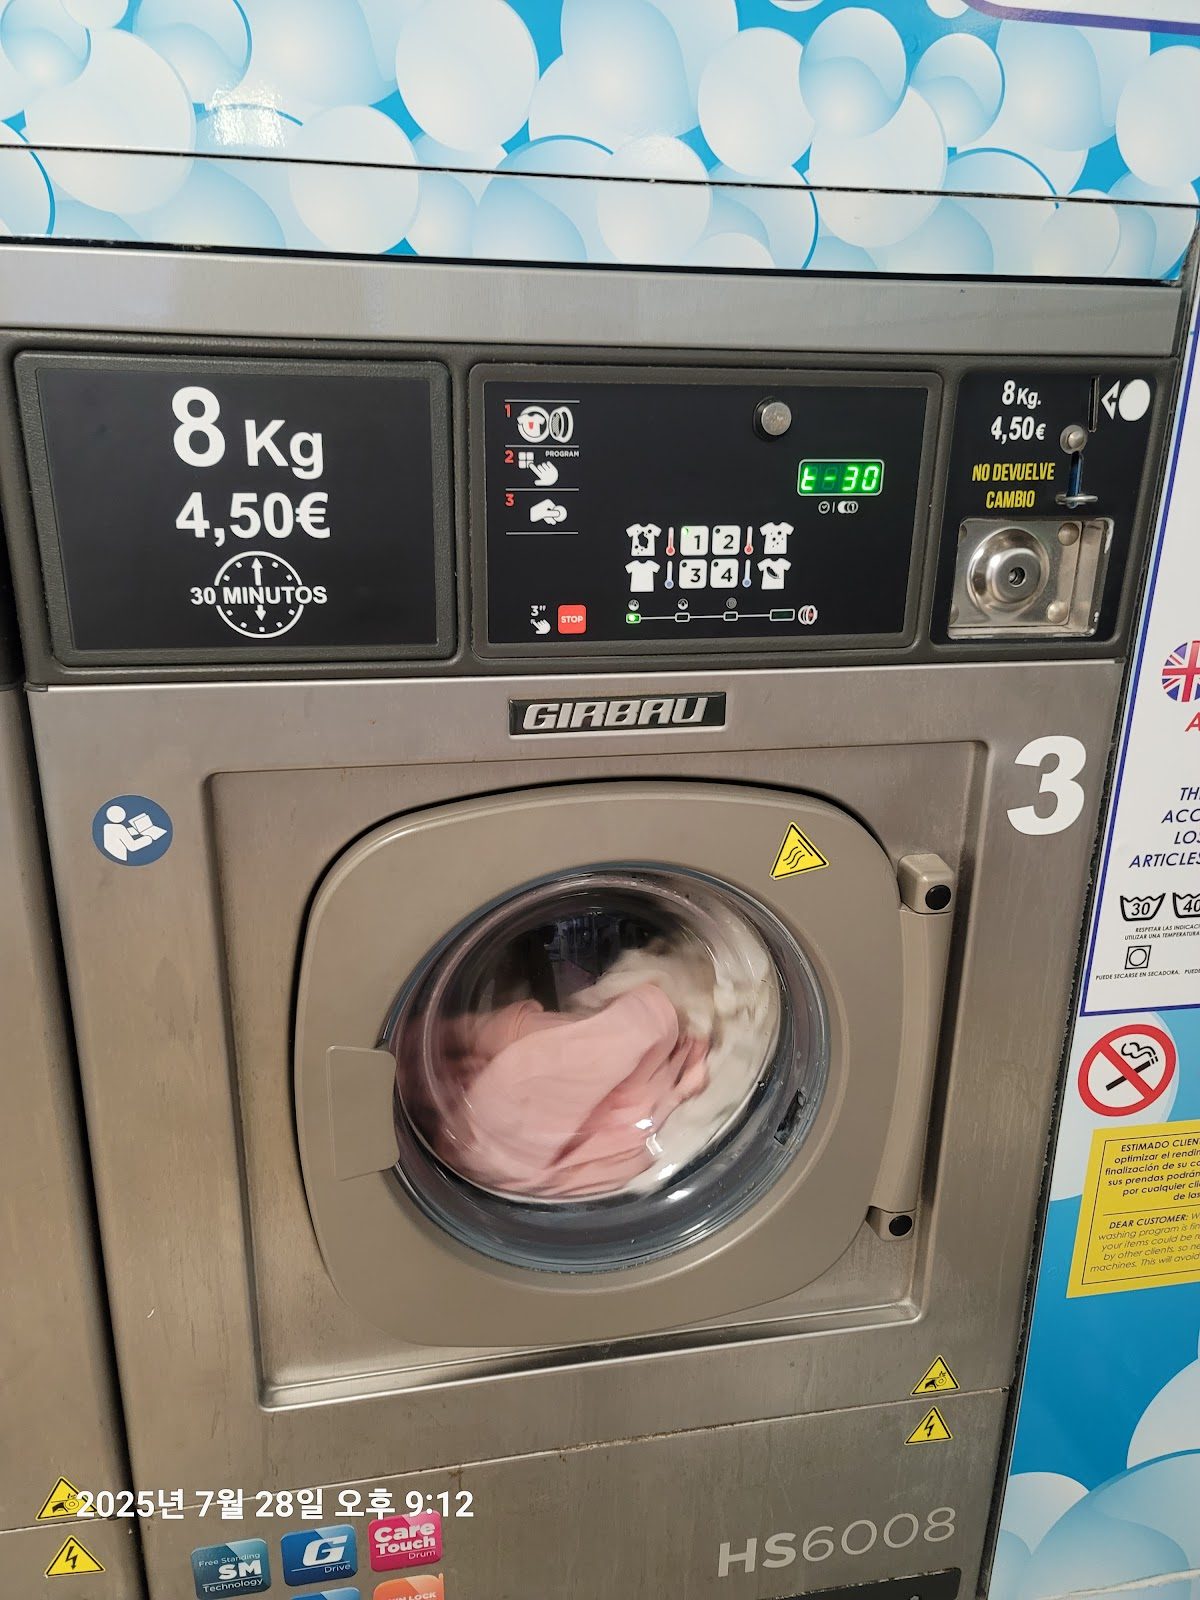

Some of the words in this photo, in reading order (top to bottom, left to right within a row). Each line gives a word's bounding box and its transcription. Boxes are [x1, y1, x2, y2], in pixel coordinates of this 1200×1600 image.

[1001, 380, 1016, 406] 8
[504, 403, 512, 418] 1
[172, 386, 226, 467] 8
[244, 419, 324, 480] Kg
[990, 416, 1046, 445] 4,50€
[504, 449, 514, 464] 2
[545, 450, 580, 458] PROGRAM
[972, 463, 990, 482] NO
[992, 462, 1056, 482] DEVUELVE
[505, 493, 515, 507] 3
[985, 489, 1036, 509] CAMBIO
[175, 491, 331, 548] 4,50€
[694, 534, 701, 550] 1
[723, 534, 734, 550] 2
[690, 568, 701, 583] 3
[721, 567, 733, 583] 4
[190, 587, 217, 605] 30
[223, 585, 328, 606] MINUTOS
[561, 615, 584, 624] STOP
[523, 698, 709, 730] GIRBAU
[1007, 735, 1086, 836] 3
[1180, 786, 1200, 801] TH
[1131, 902, 1150, 916] 30
[1095, 973, 1113, 981] PUEDE
[1113, 971, 1138, 979] SECARSE
[1121, 1140, 1169, 1152] ESTIMADO
[1114, 1153, 1158, 1165] optimizar
[1161, 1151, 1170, 1160] el
[1105, 1162, 1160, 1176] finalización
[1162, 1162, 1175, 1170] de
[1177, 1161, 1187, 1169] su
[1108, 1178, 1123, 1187] sus
[1125, 1174, 1164, 1186] prendas
[1122, 1188, 1138, 1197] por
[1141, 1182, 1186, 1194] cualquier
[1173, 1193, 1185, 1201] de
[1109, 1219, 1134, 1229] DEAR
[1136, 1213, 1189, 1226] CUSTOMER:
[1098, 1229, 1137, 1240] washing
[1138, 1225, 1179, 1238] program
[1181, 1223, 1187, 1232] is
[1101, 1242, 1124, 1252] your
[1124, 1239, 1149, 1248] items
[1151, 1234, 1178, 1245] could
[1180, 1232, 1193, 1242] be
[1103, 1252, 1116, 1262] by
[1117, 1249, 1142, 1259] other
[1177, 1244, 1188, 1252] so
[1090, 1261, 1137, 1273] machines.
[1140, 1257, 1156, 1267] This
[1158, 1254, 1173, 1264] will
[374, 1522, 436, 1543] Care
[376, 1535, 436, 1555] Touch
[717, 1507, 956, 1577] HS6008
[302, 1535, 348, 1567] G
[408, 1550, 436, 1560] Drum
[198, 1559, 219, 1568] Free
[221, 1553, 261, 1564] Standing
[324, 1563, 351, 1574] Drive
[218, 1559, 262, 1580] SM
[203, 1578, 263, 1593] Technology
